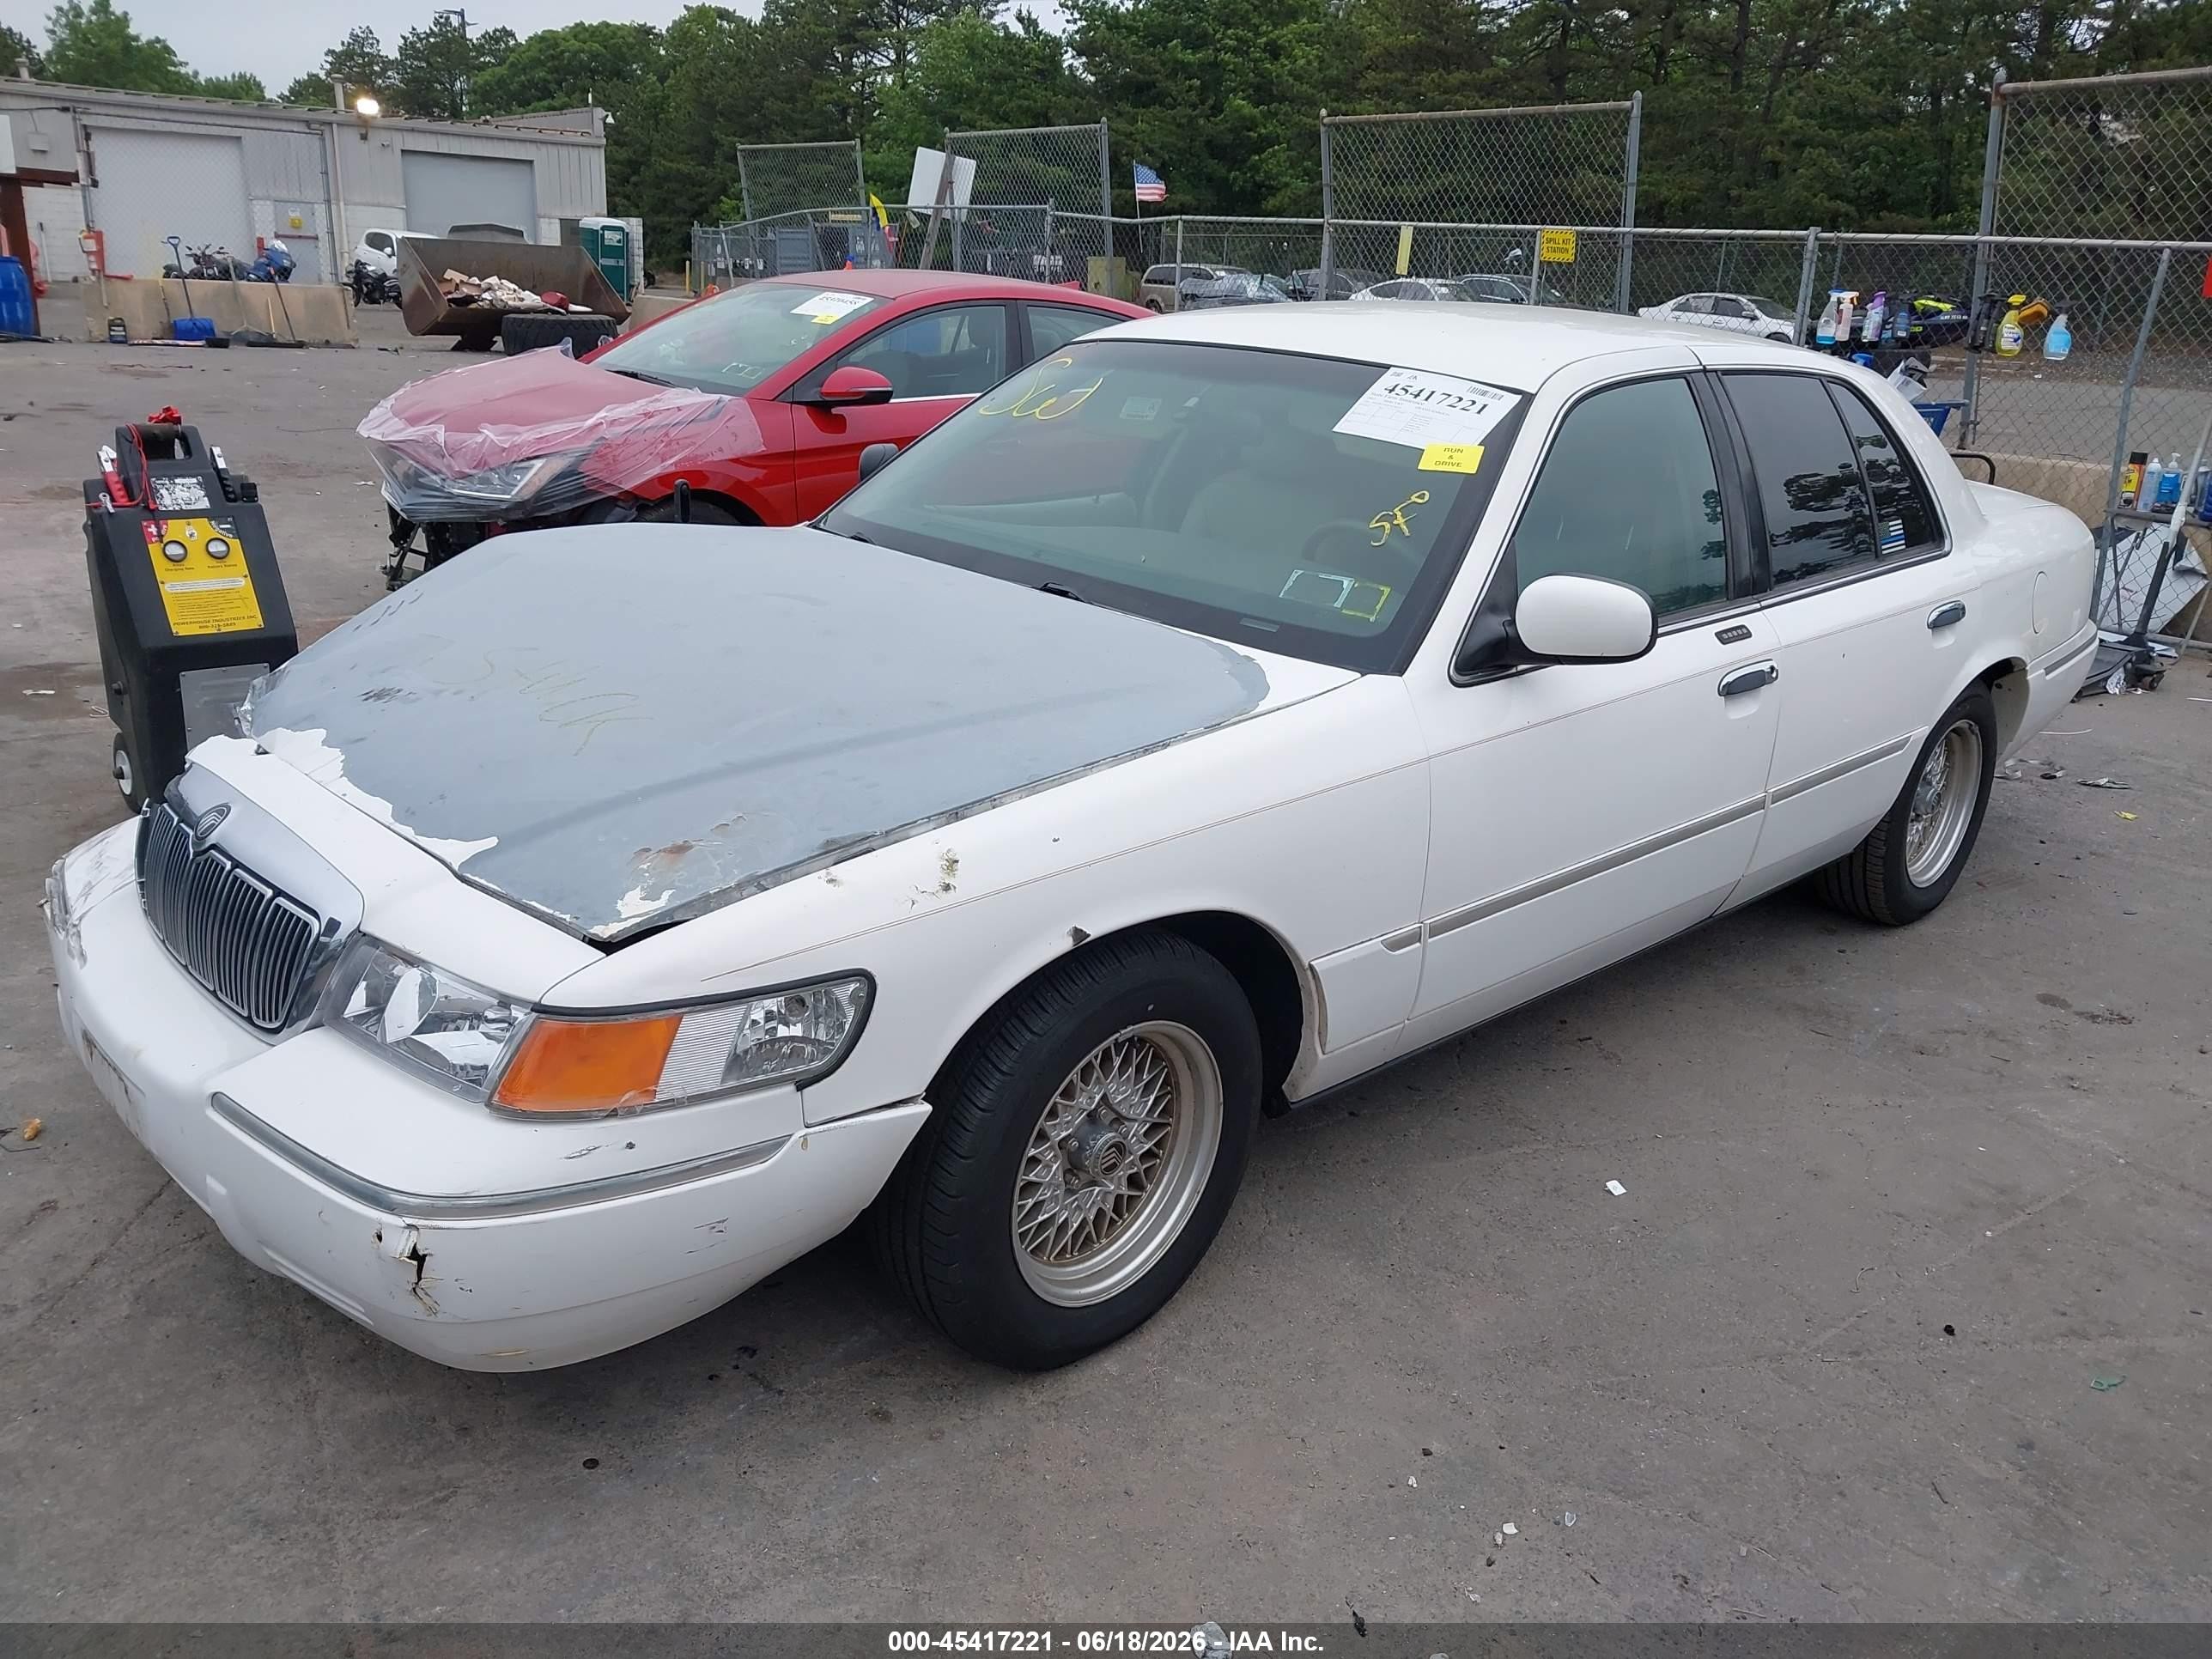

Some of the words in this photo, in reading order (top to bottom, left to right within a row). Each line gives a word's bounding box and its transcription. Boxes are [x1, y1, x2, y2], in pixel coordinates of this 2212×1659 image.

[1545, 237, 1560, 246] SPILL
[1546, 246, 1569, 255] STATION
[1384, 383, 1490, 415] 45417221
